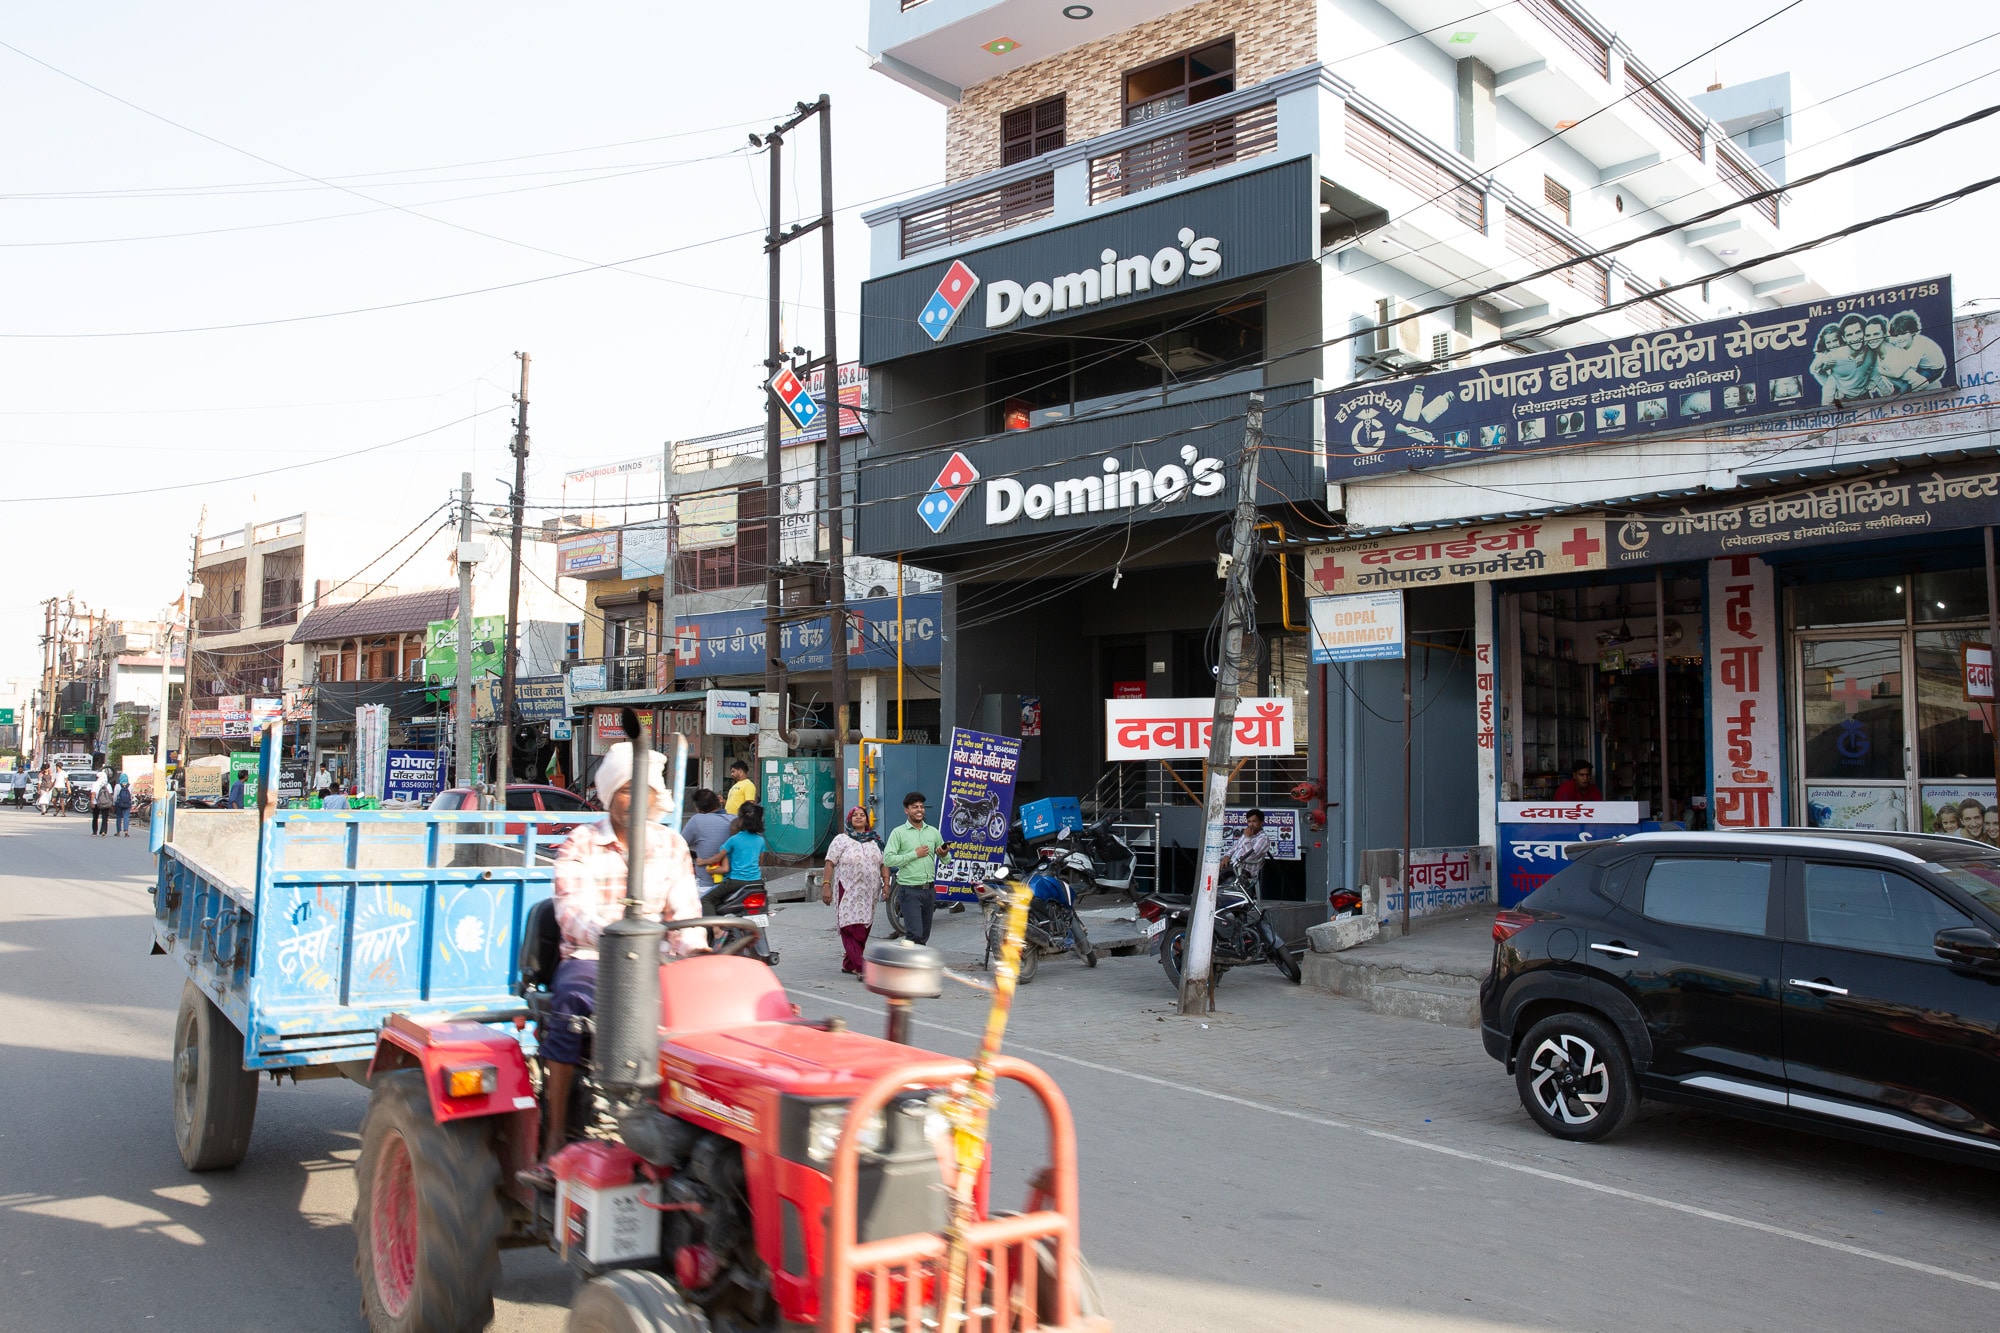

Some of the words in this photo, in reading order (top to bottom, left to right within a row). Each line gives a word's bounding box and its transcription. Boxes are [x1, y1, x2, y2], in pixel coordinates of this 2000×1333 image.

[986, 227, 1222, 328] Domino's
[1837, 283, 1940, 312] 9711131758
[1459, 367, 1545, 402] गोपाल
[1549, 331, 1718, 392] होम्योहीलिंग
[1724, 319, 1810, 358] सेन्टर
[1353, 453, 1385, 467] GHHC
[585, 466, 617, 478] CURIOUS
[618, 461, 643, 472] MINDS
[986, 444, 1226, 525] Domino's
[1662, 507, 1745, 536] गोपाल
[1918, 472, 2000, 504] सेन्टर
[1358, 524, 1543, 565] दवाईयाँ
[1620, 550, 1650, 561] GHHC
[1357, 566, 1442, 587] गोपाल
[1449, 549, 1547, 576] फार्मेसी
[1335, 610, 1377, 627] GOPAL
[872, 617, 934, 643] HDFC
[1320, 627, 1394, 646] PHARMACY
[707, 633, 726, 657] एच
[730, 626, 745, 652] डी
[545, 684, 563, 696] जोन
[599, 713, 613, 727] FOR
[390, 753, 442, 769] गोपाल
[953, 746, 969, 764] नरेश
[393, 771, 415, 779] पॉवर
[954, 766, 963, 777] व
[964, 765, 989, 780] स्पेयर
